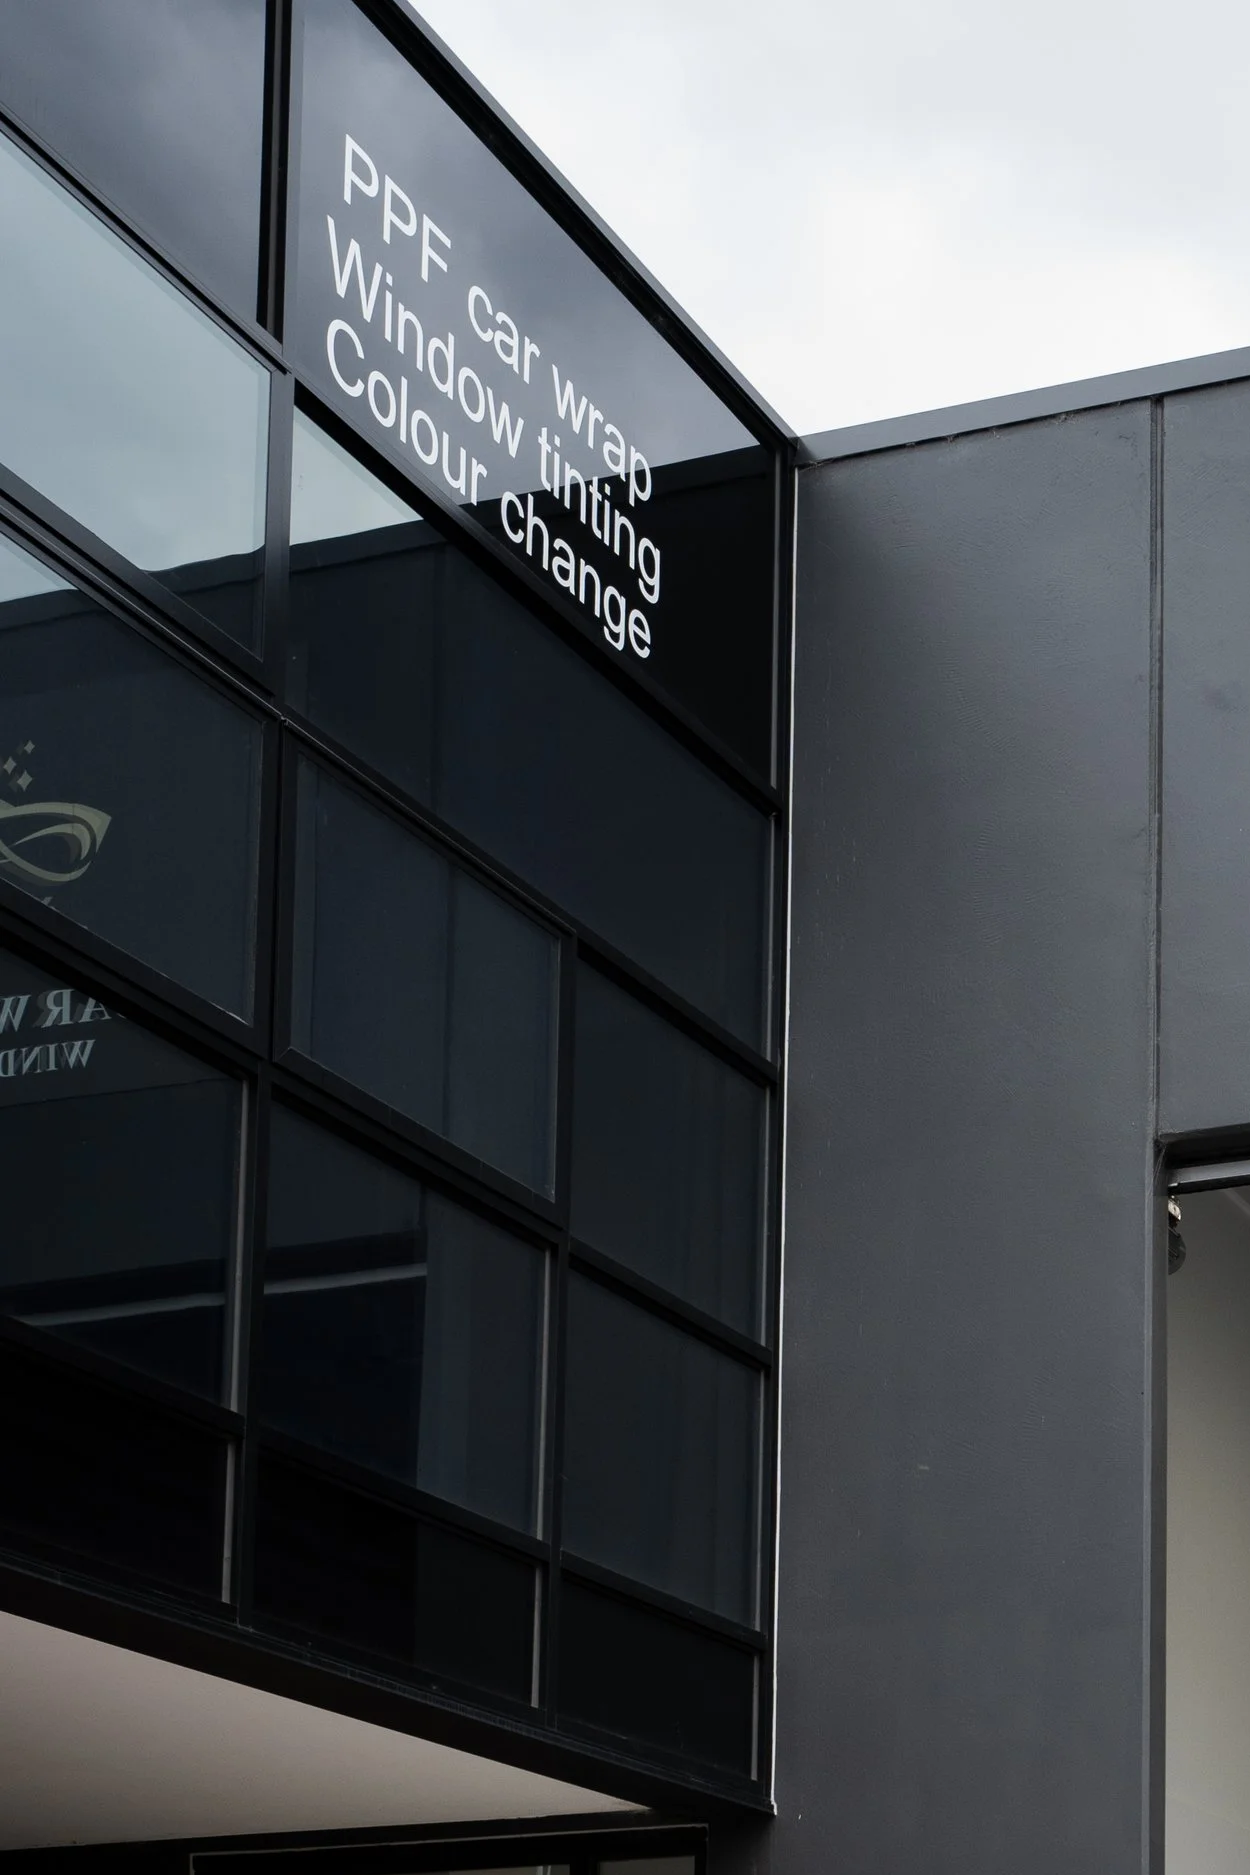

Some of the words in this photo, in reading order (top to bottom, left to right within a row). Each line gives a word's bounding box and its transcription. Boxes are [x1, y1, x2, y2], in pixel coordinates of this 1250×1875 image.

[326, 214, 524, 458] Window
[537, 426, 660, 604] tinting
[326, 319, 487, 506] Colour
[500, 490, 651, 658] change
[344, 133, 451, 282] PPF
[467, 285, 540, 384] car
[552, 363, 652, 506] wrap
